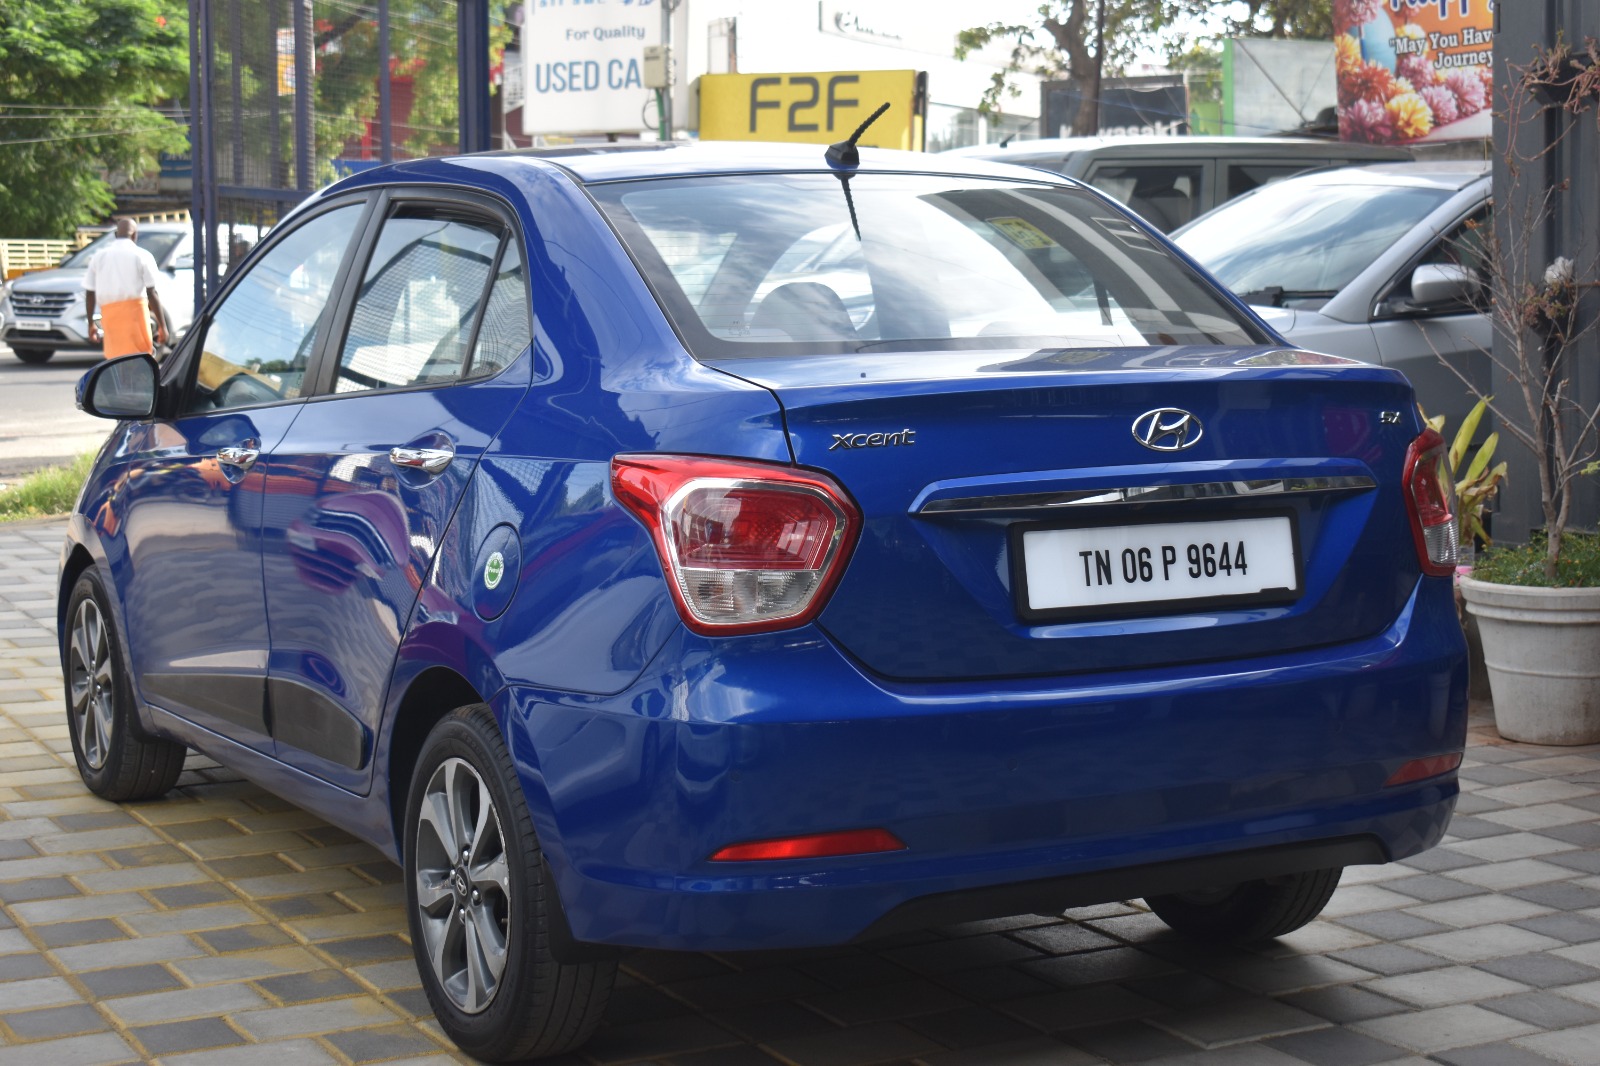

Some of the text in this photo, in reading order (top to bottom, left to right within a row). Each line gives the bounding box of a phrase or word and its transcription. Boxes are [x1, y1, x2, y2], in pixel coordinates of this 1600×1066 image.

[565, 25, 646, 42] For Quality
[1428, 32, 1459, 50] You
[1462, 26, 1494, 46] Hav
[535, 59, 600, 94] USED
[749, 74, 860, 133] F2F
[1078, 541, 1248, 587] TN 06 P 9644
